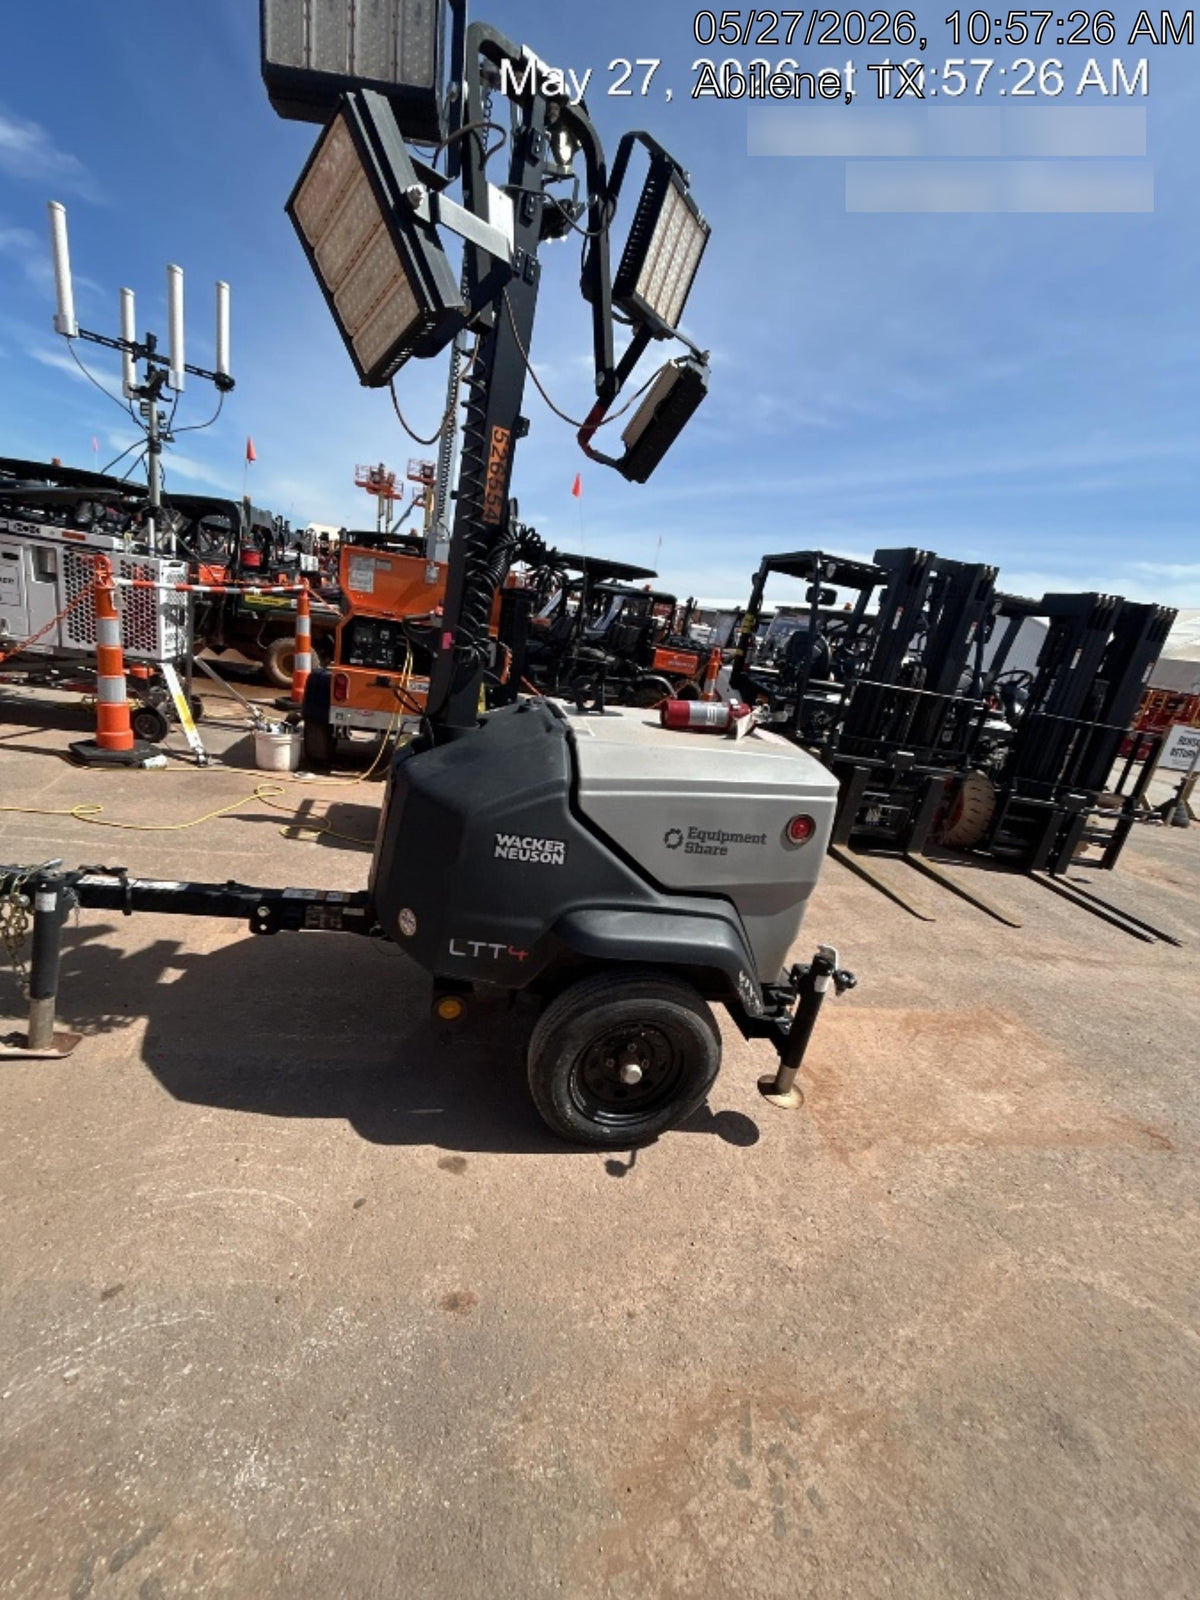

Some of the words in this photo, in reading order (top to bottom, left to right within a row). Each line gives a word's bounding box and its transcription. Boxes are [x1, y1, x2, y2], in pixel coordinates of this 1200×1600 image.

[495, 833, 566, 855] WACKER
[687, 826, 767, 845] Equipment
[494, 846, 566, 865] NEUSON
[684, 841, 728, 856] Share
[449, 939, 528, 960] LTT4
